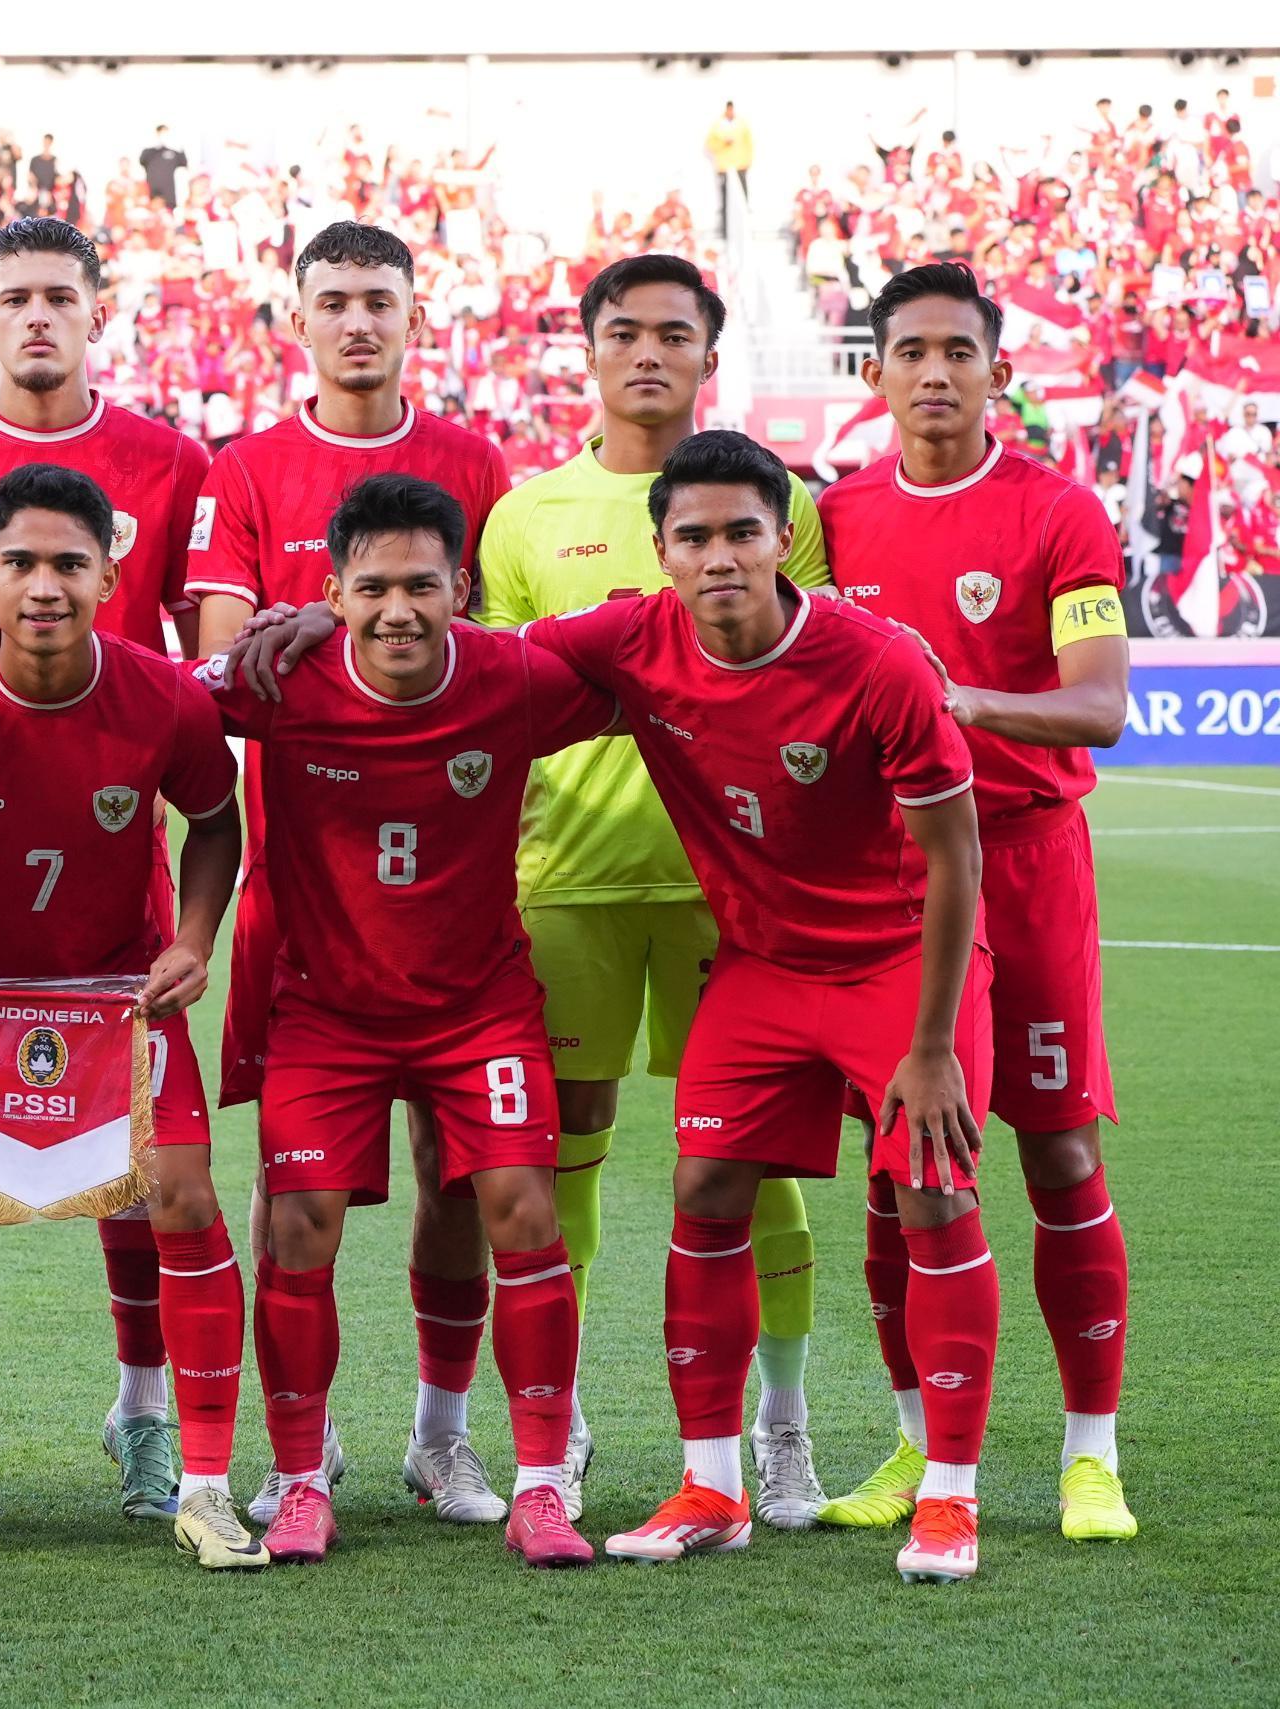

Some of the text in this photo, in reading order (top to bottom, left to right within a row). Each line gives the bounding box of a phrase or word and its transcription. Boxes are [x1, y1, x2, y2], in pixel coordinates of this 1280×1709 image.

[556, 542, 608, 558] erspo
[843, 584, 881, 599] erspo
[1059, 597, 1119, 635] AFC
[649, 714, 693, 741] erspo
[306, 763, 360, 782] erspo
[724, 785, 765, 838] 3
[377, 822, 418, 886] 8
[25, 849, 64, 912] 7
[34, 1045, 52, 1053] PSSI
[549, 1036, 580, 1049] spo
[1027, 1020, 1069, 1090] 5
[485, 1056, 528, 1125] 8
[4, 1093, 76, 1117] PSSI
[679, 1116, 723, 1131] erspo
[274, 1149, 325, 1164] erspo
[179, 1364, 241, 1378] INDONES
